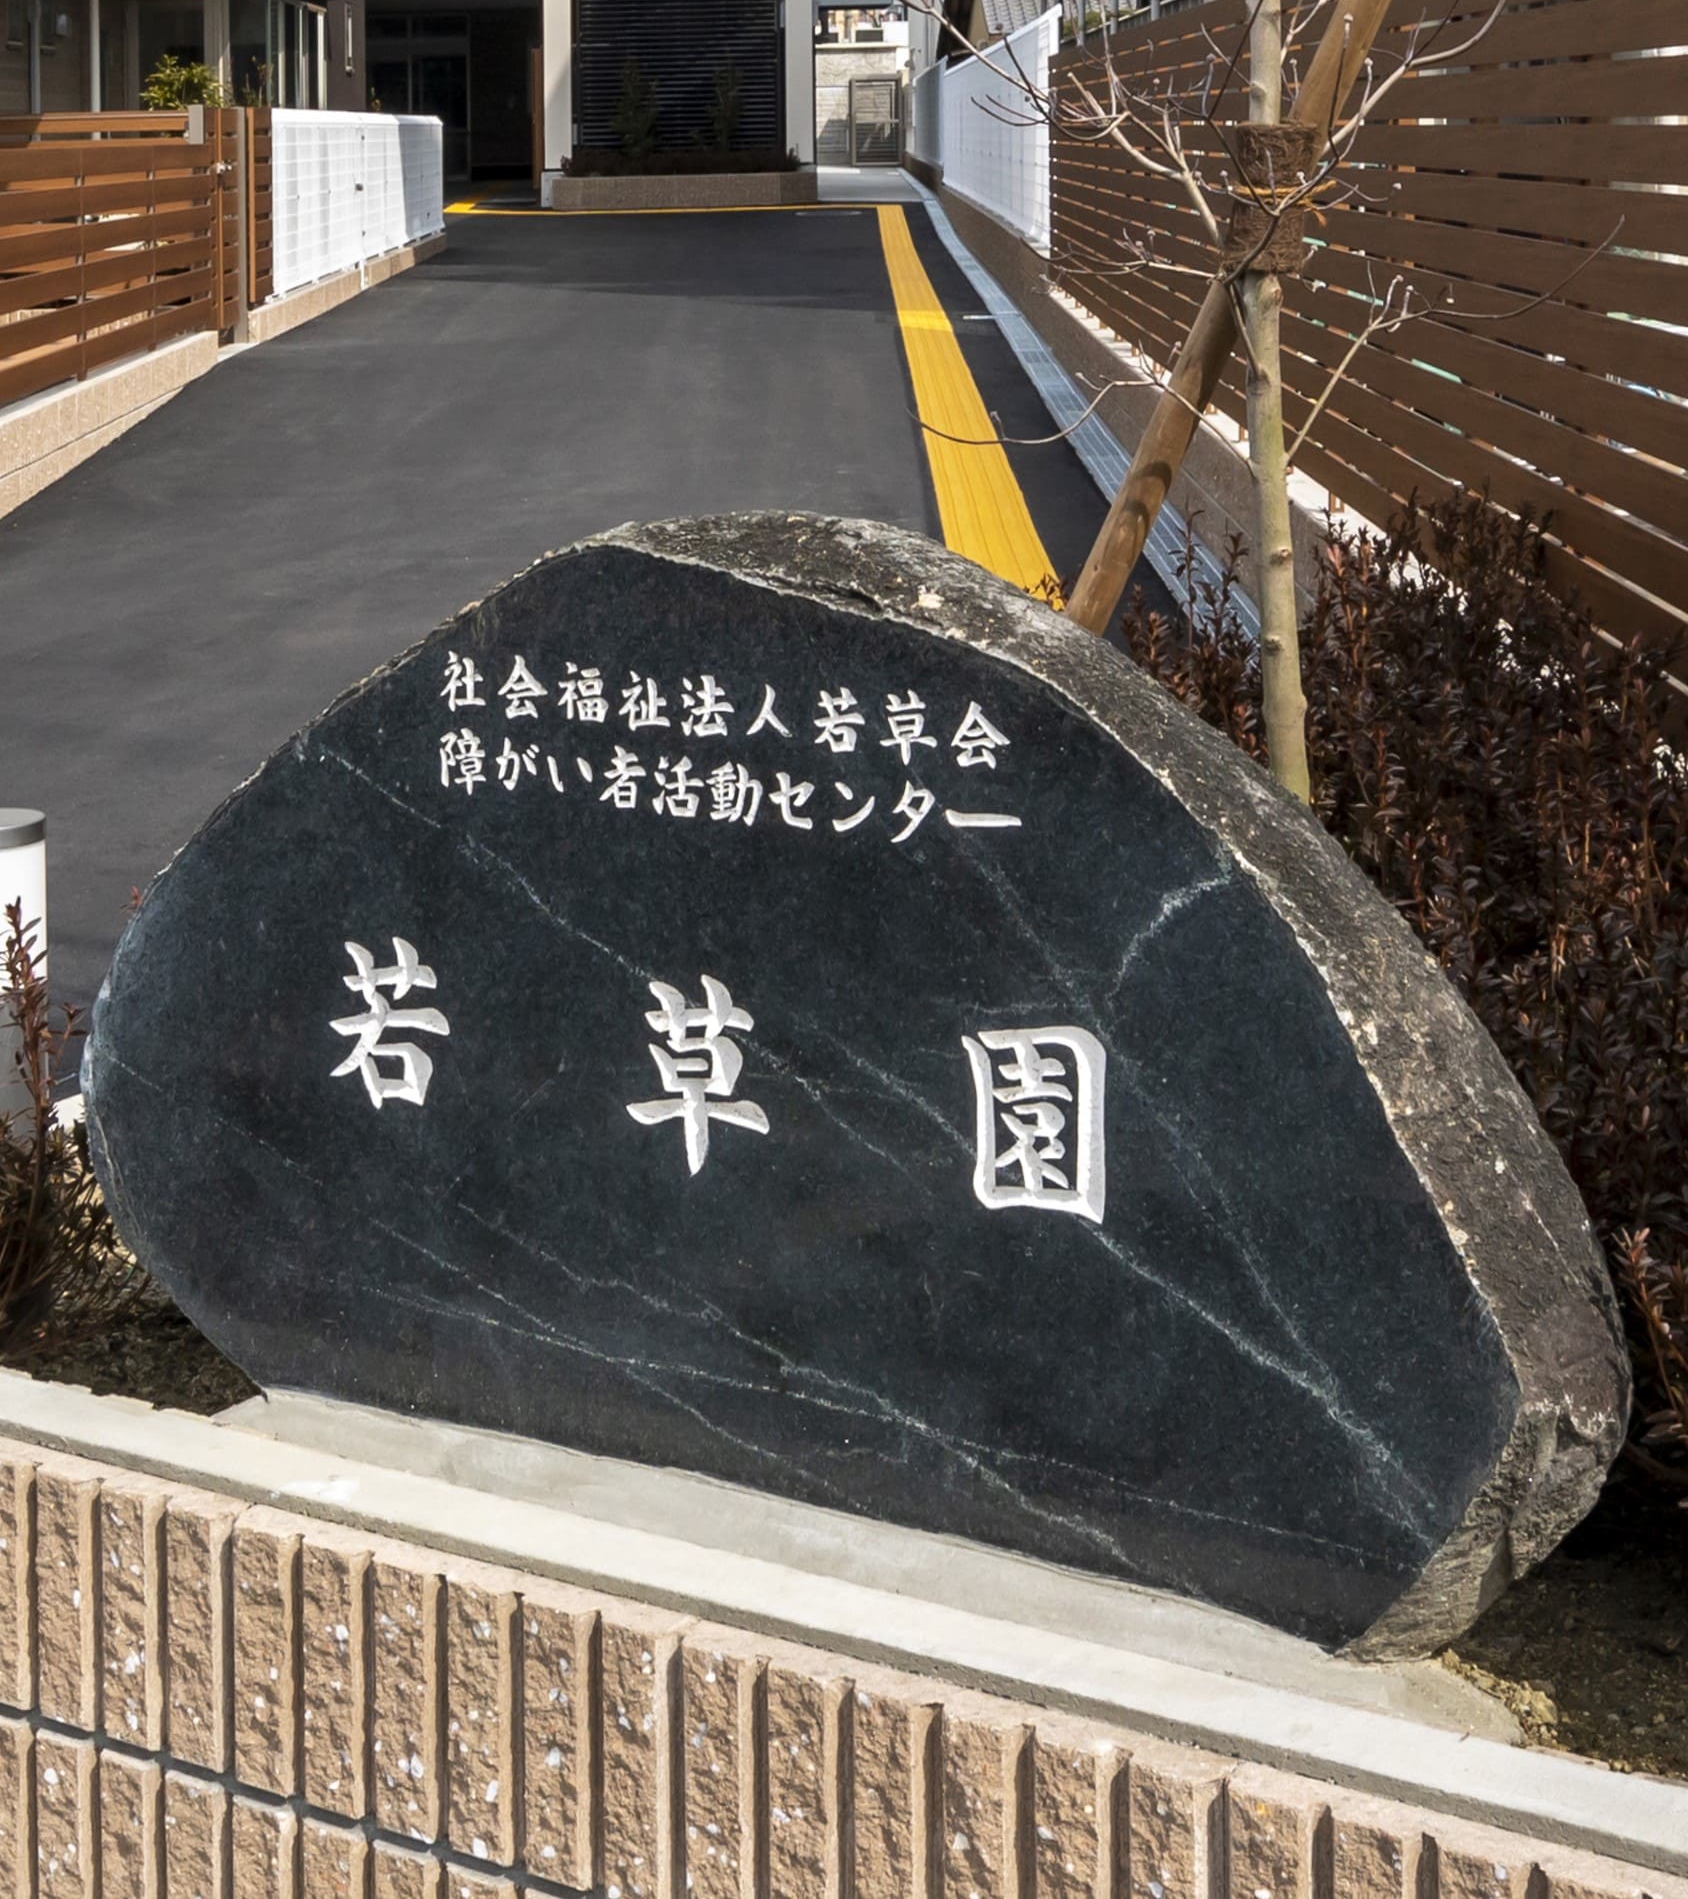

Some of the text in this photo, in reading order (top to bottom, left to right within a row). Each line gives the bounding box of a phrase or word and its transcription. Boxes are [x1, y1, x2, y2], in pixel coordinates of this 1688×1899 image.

[438, 649, 1012, 770] 社会福祉法人若草会
[438, 727, 1023, 843] 障がい者活動センター
[328, 935, 1108, 1226] 若草園
